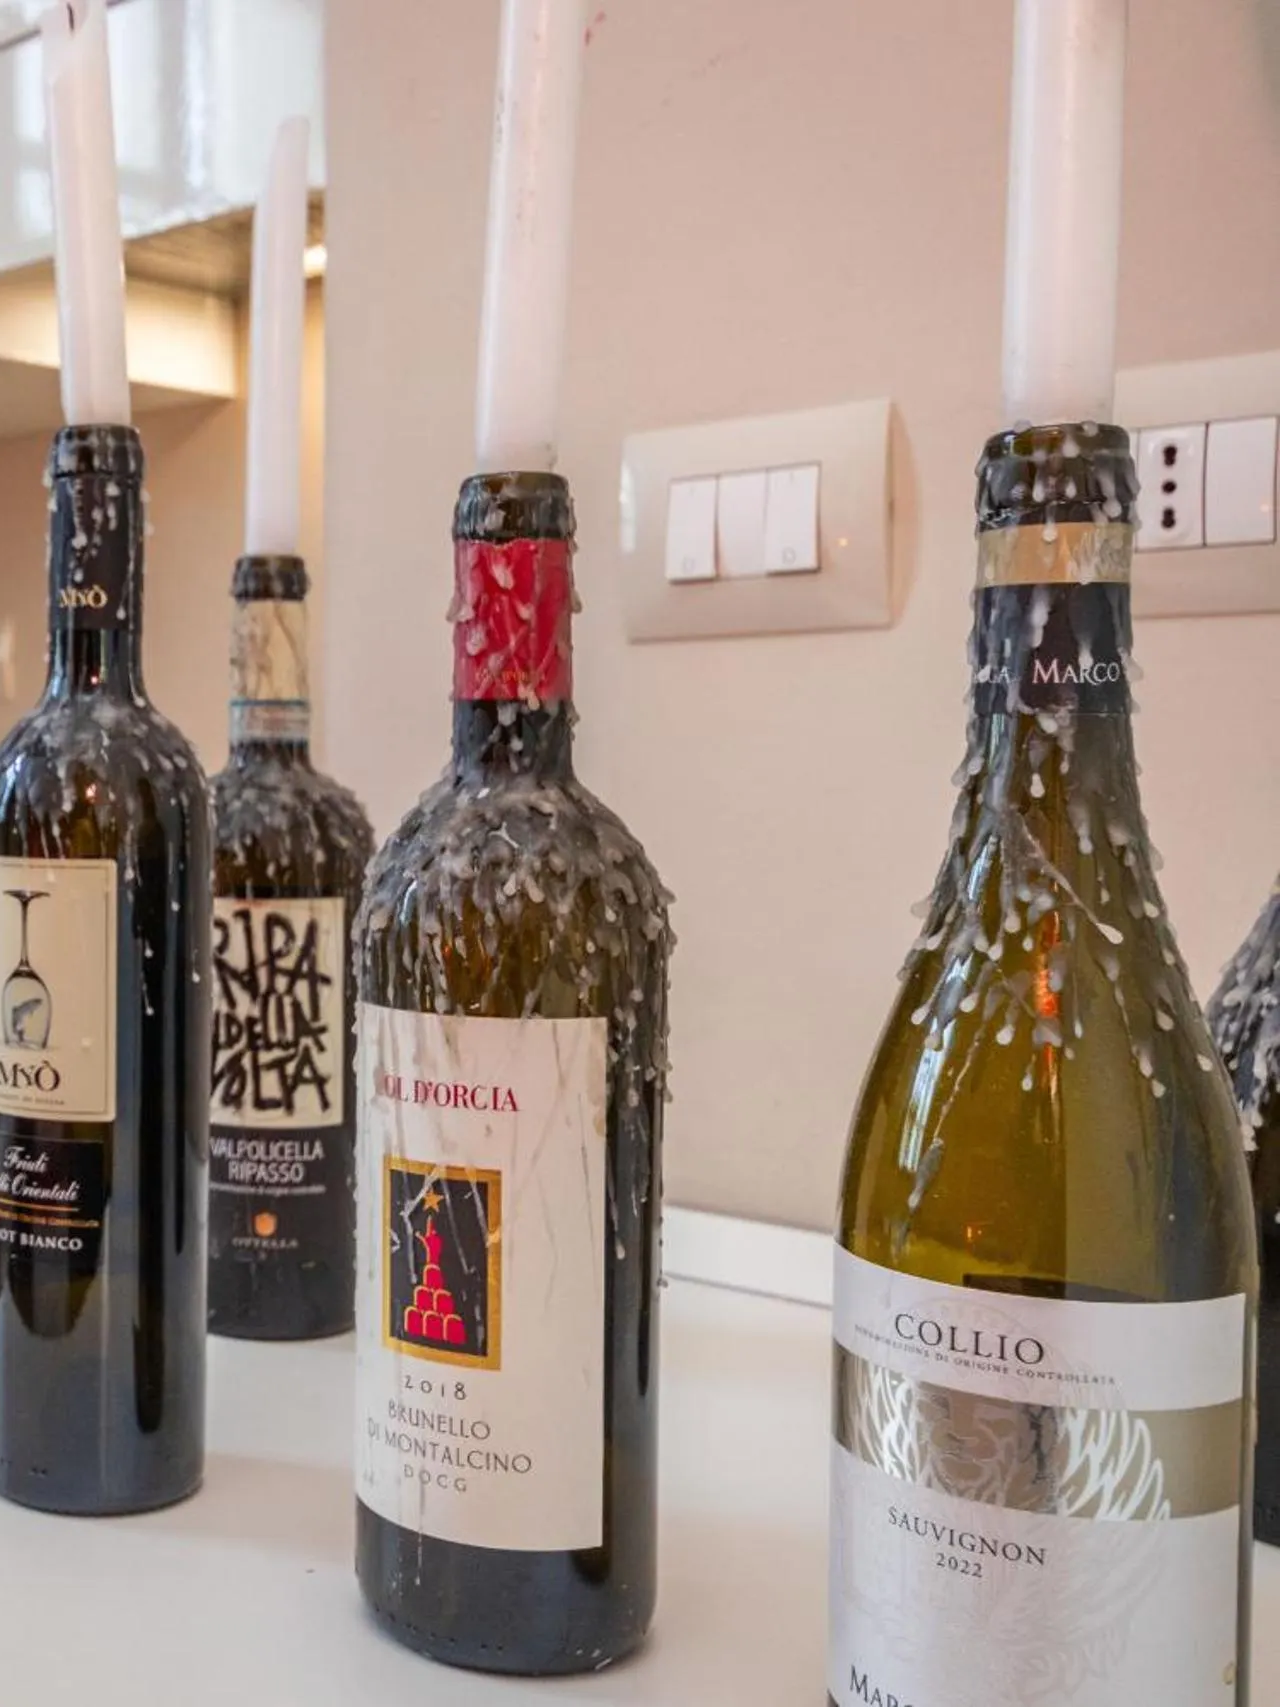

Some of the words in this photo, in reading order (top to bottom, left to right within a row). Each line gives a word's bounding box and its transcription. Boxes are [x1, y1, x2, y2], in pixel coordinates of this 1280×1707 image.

[1031, 658, 1121, 686] MARCO
[413, 1079, 524, 1112] D'ORCIA
[209, 1137, 325, 1161] VALPOLICELLA
[228, 1160, 305, 1183] RIPASSO
[11, 1173, 80, 1200] Orientali
[20, 1232, 83, 1251] BIANCO
[894, 1313, 1045, 1365] COLLIO
[953, 1357, 1009, 1375] ORIGINE
[404, 1374, 467, 1401] 2018
[388, 1400, 492, 1440] BRUNELLO
[367, 1416, 380, 1441] DI
[384, 1424, 532, 1474] MONTALCINO
[887, 1505, 1047, 1566] SAUVIGNON
[935, 1552, 983, 1578] 2022
